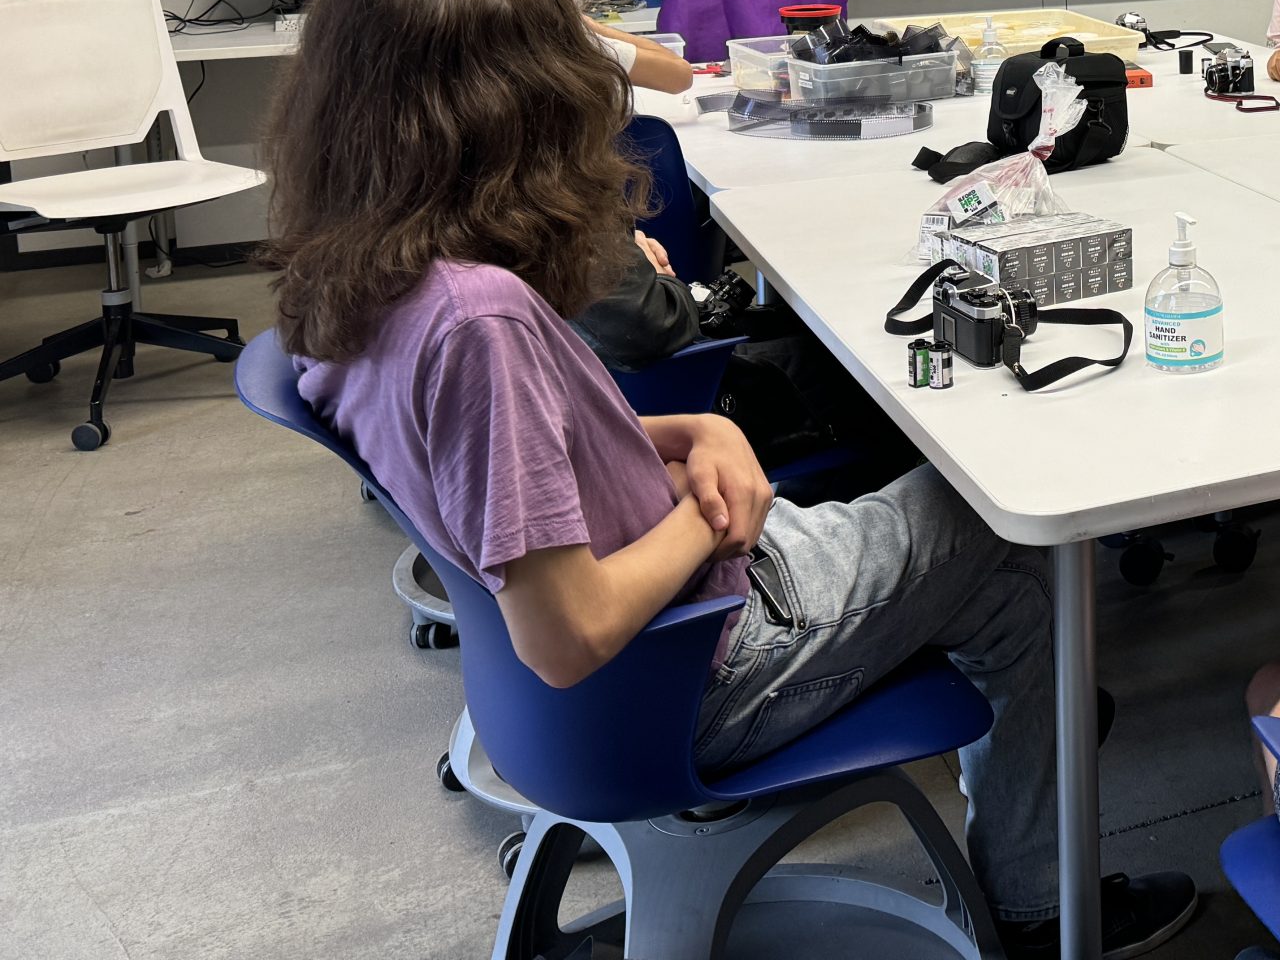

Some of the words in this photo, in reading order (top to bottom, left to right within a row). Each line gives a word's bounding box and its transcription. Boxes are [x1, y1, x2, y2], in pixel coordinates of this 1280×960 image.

[957, 189, 976, 202] ILFORD
[960, 194, 980, 210] HP5
[1151, 319, 1181, 327] ADVANCED
[1155, 326, 1176, 334] HAND
[1149, 331, 1187, 342] SANITIZER
